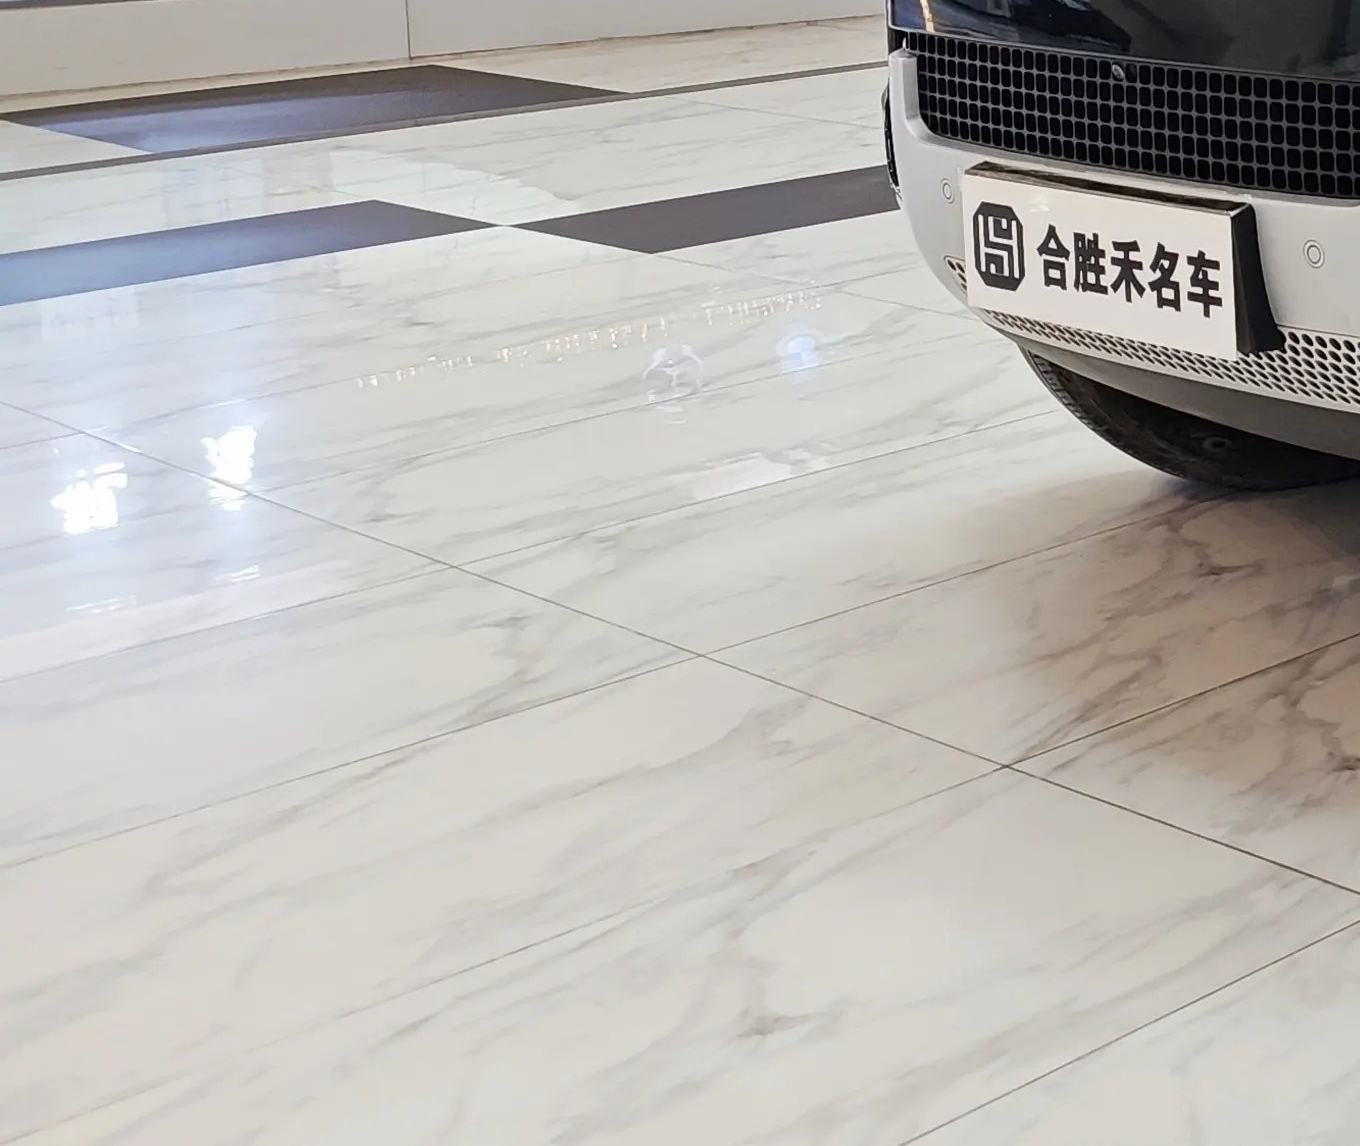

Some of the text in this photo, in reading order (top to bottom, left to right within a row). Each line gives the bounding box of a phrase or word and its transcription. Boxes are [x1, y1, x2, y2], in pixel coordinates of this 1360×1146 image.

[1036, 224, 1224, 318] 合胜禾名车
